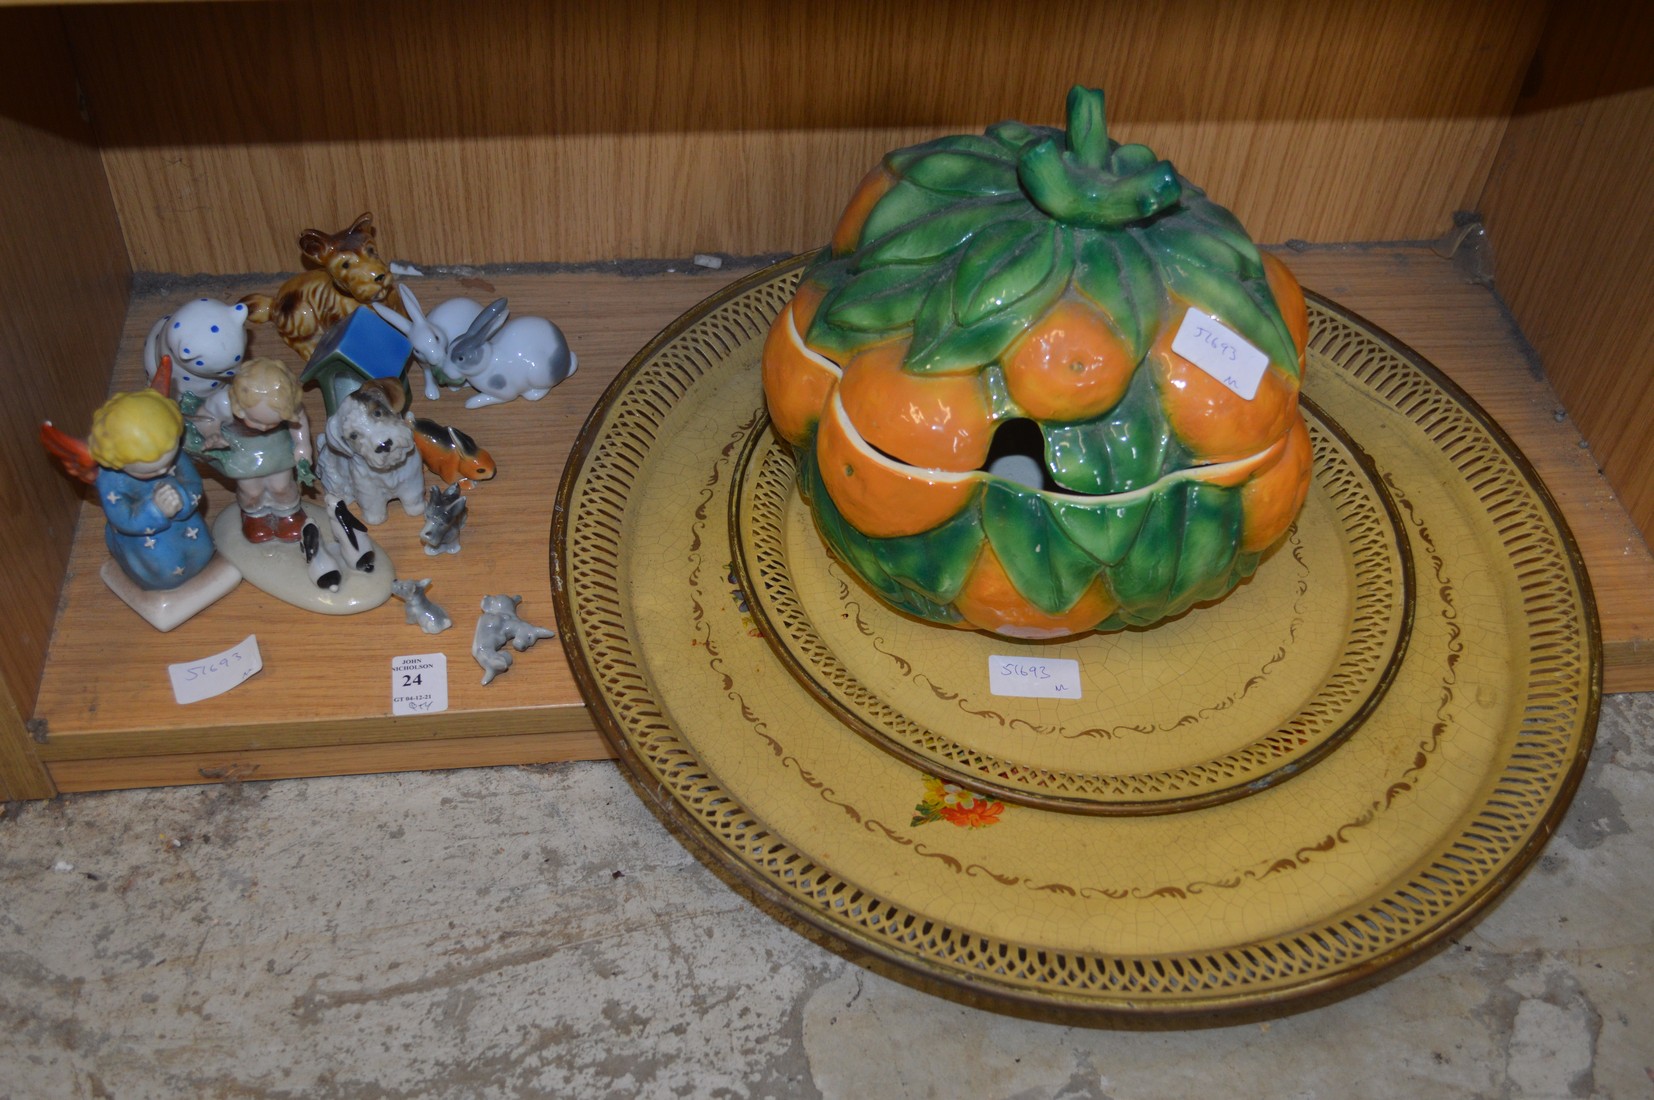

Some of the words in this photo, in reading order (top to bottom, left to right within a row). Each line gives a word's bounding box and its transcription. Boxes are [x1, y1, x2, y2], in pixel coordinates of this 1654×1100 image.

[184, 652, 242, 681] 51693
[392, 663, 434, 672] NICHOLSON
[1001, 663, 1051, 679] 51693
[402, 673, 423, 687] 24
[405, 694, 432, 702] 04-12-21
